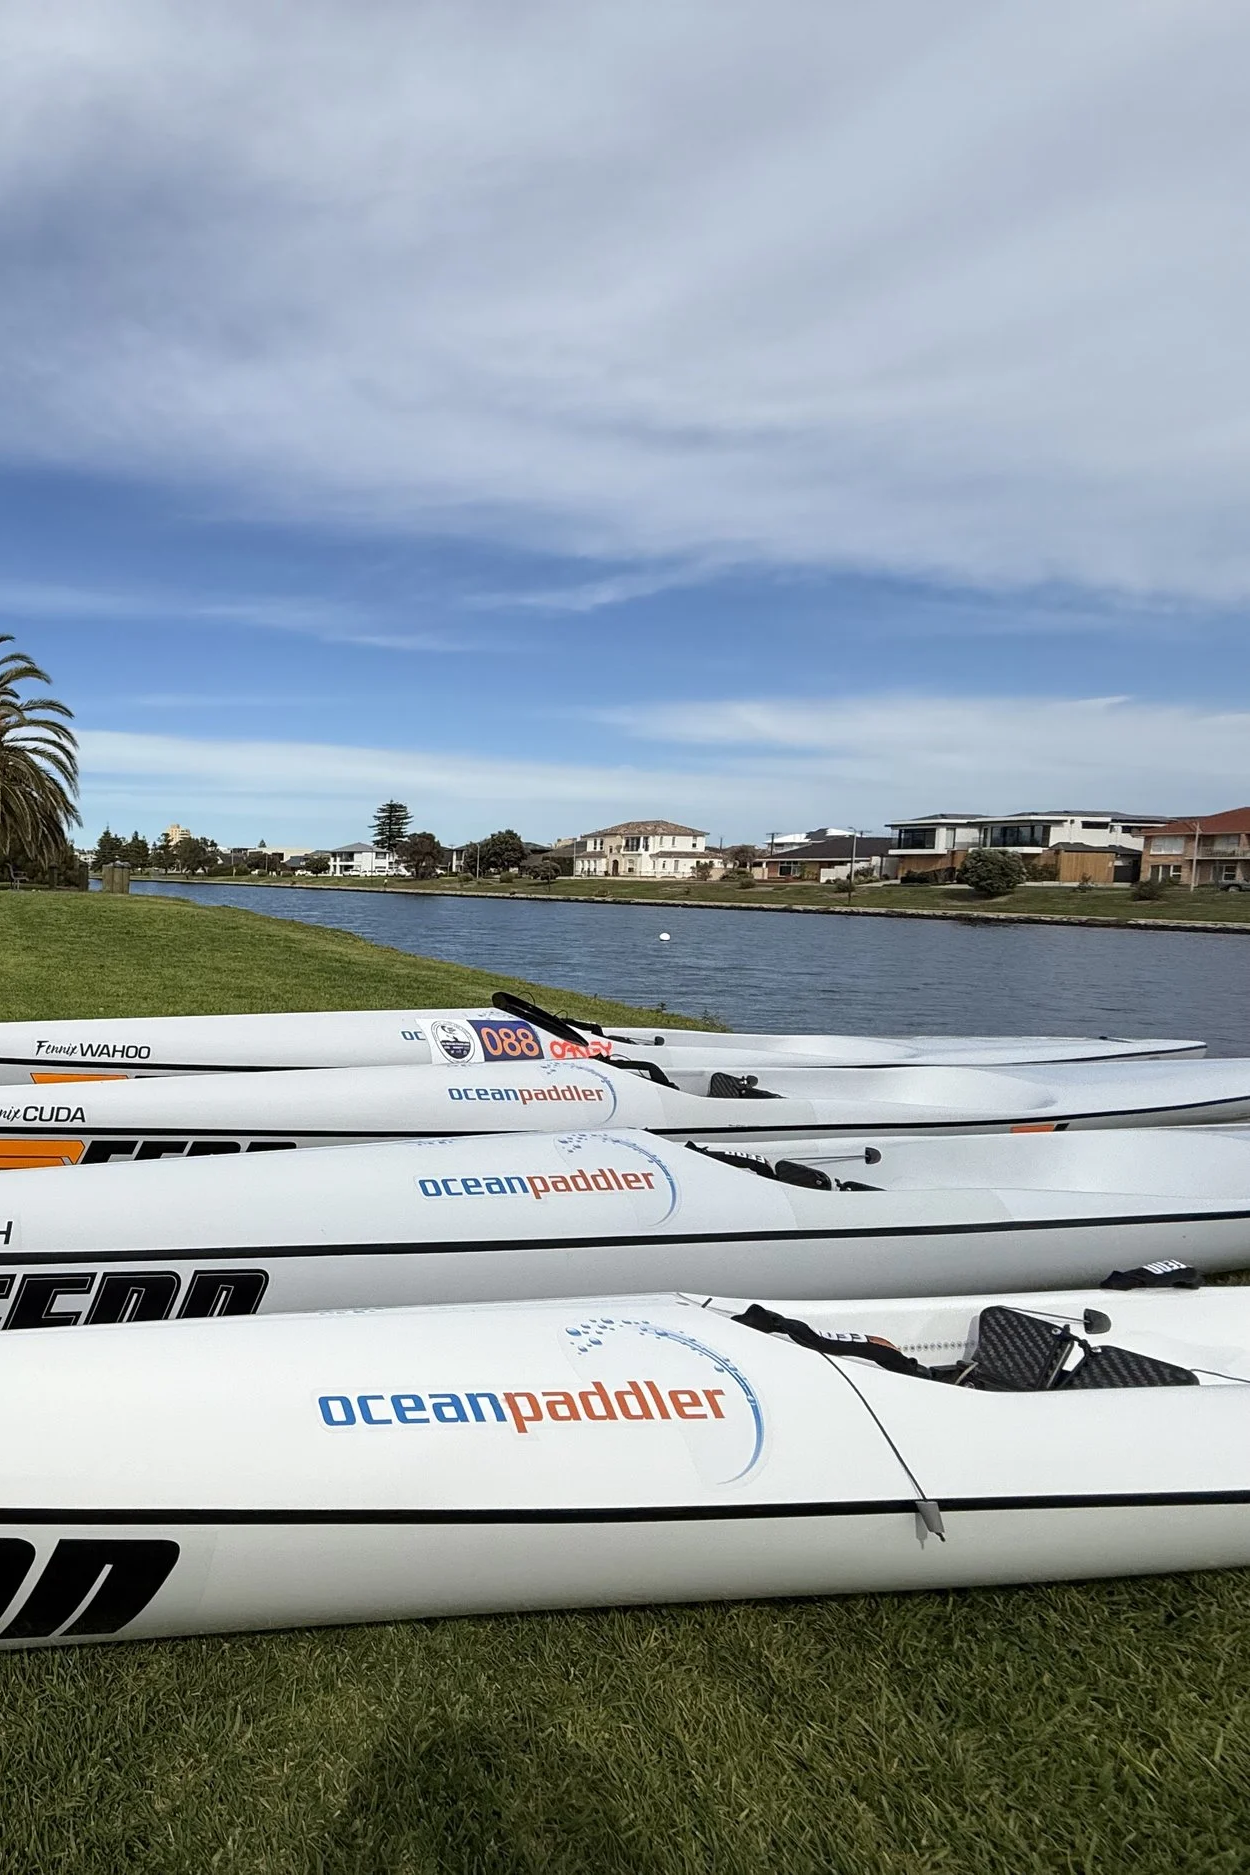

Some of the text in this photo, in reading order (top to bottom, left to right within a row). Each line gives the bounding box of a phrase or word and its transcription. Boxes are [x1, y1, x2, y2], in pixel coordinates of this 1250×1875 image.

[35, 1040, 151, 1059] Fennix WAHOO
[480, 1027, 541, 1057] 088
[447, 1085, 604, 1105] oceanpaddler
[22, 1106, 86, 1123] CUDA
[417, 1168, 655, 1200] oceanpaddler
[317, 1380, 727, 1434] oceanpaddler
